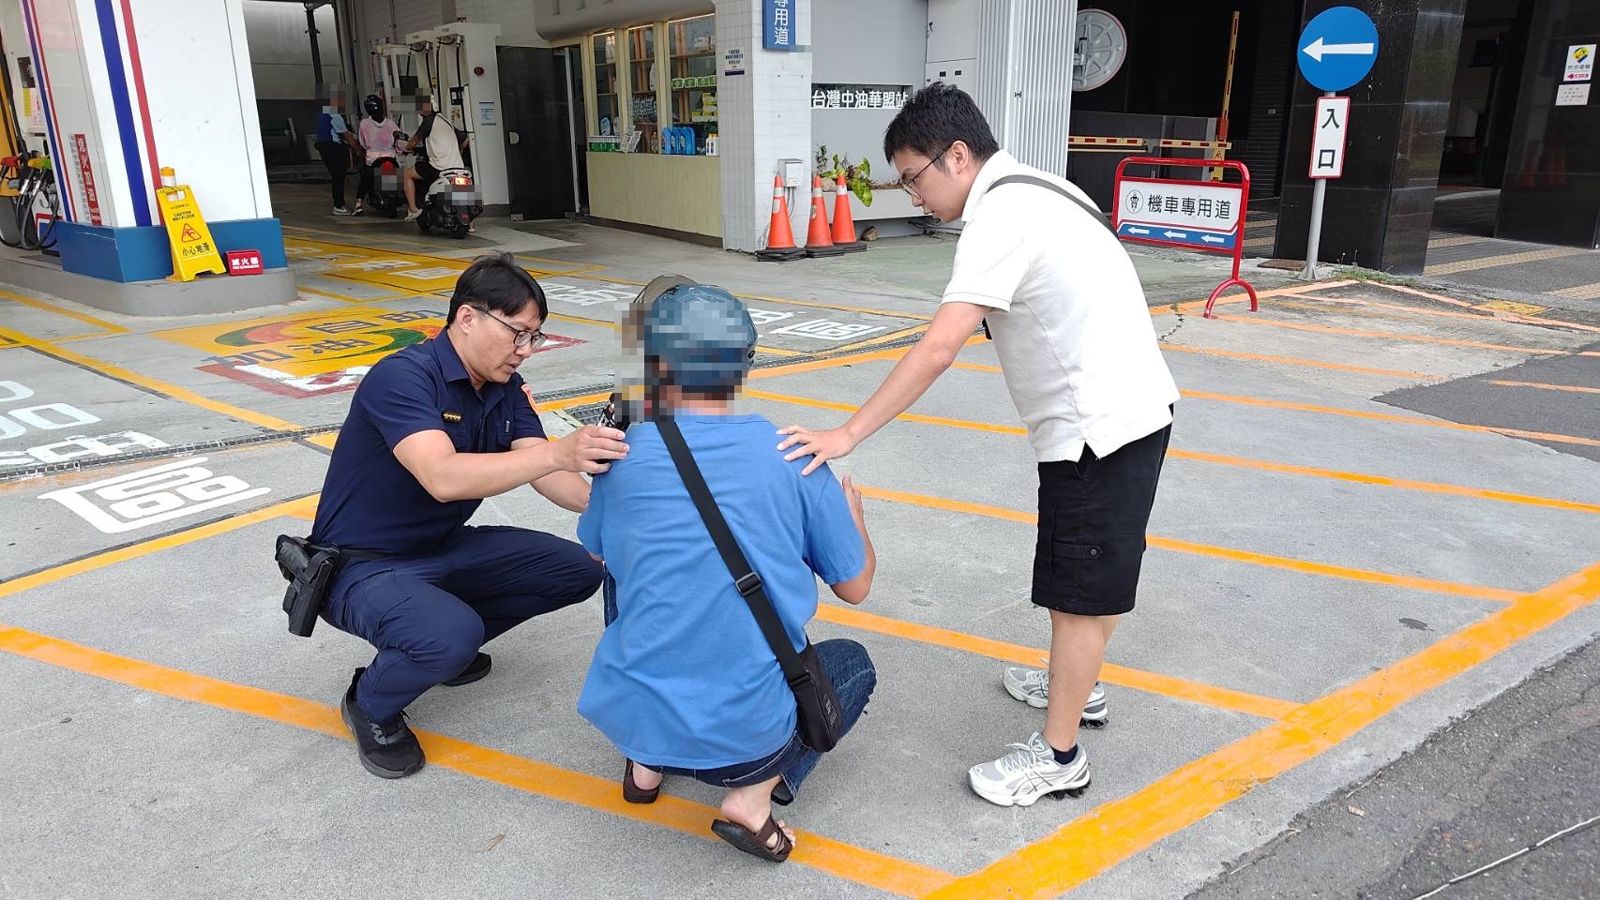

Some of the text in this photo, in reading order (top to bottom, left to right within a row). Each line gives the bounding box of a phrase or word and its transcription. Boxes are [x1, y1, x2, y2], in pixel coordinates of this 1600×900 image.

[812, 89, 908, 109] 台灣中油華盟站
[1318, 108, 1340, 168] 入口
[1148, 194, 1231, 219] 機車專用道
